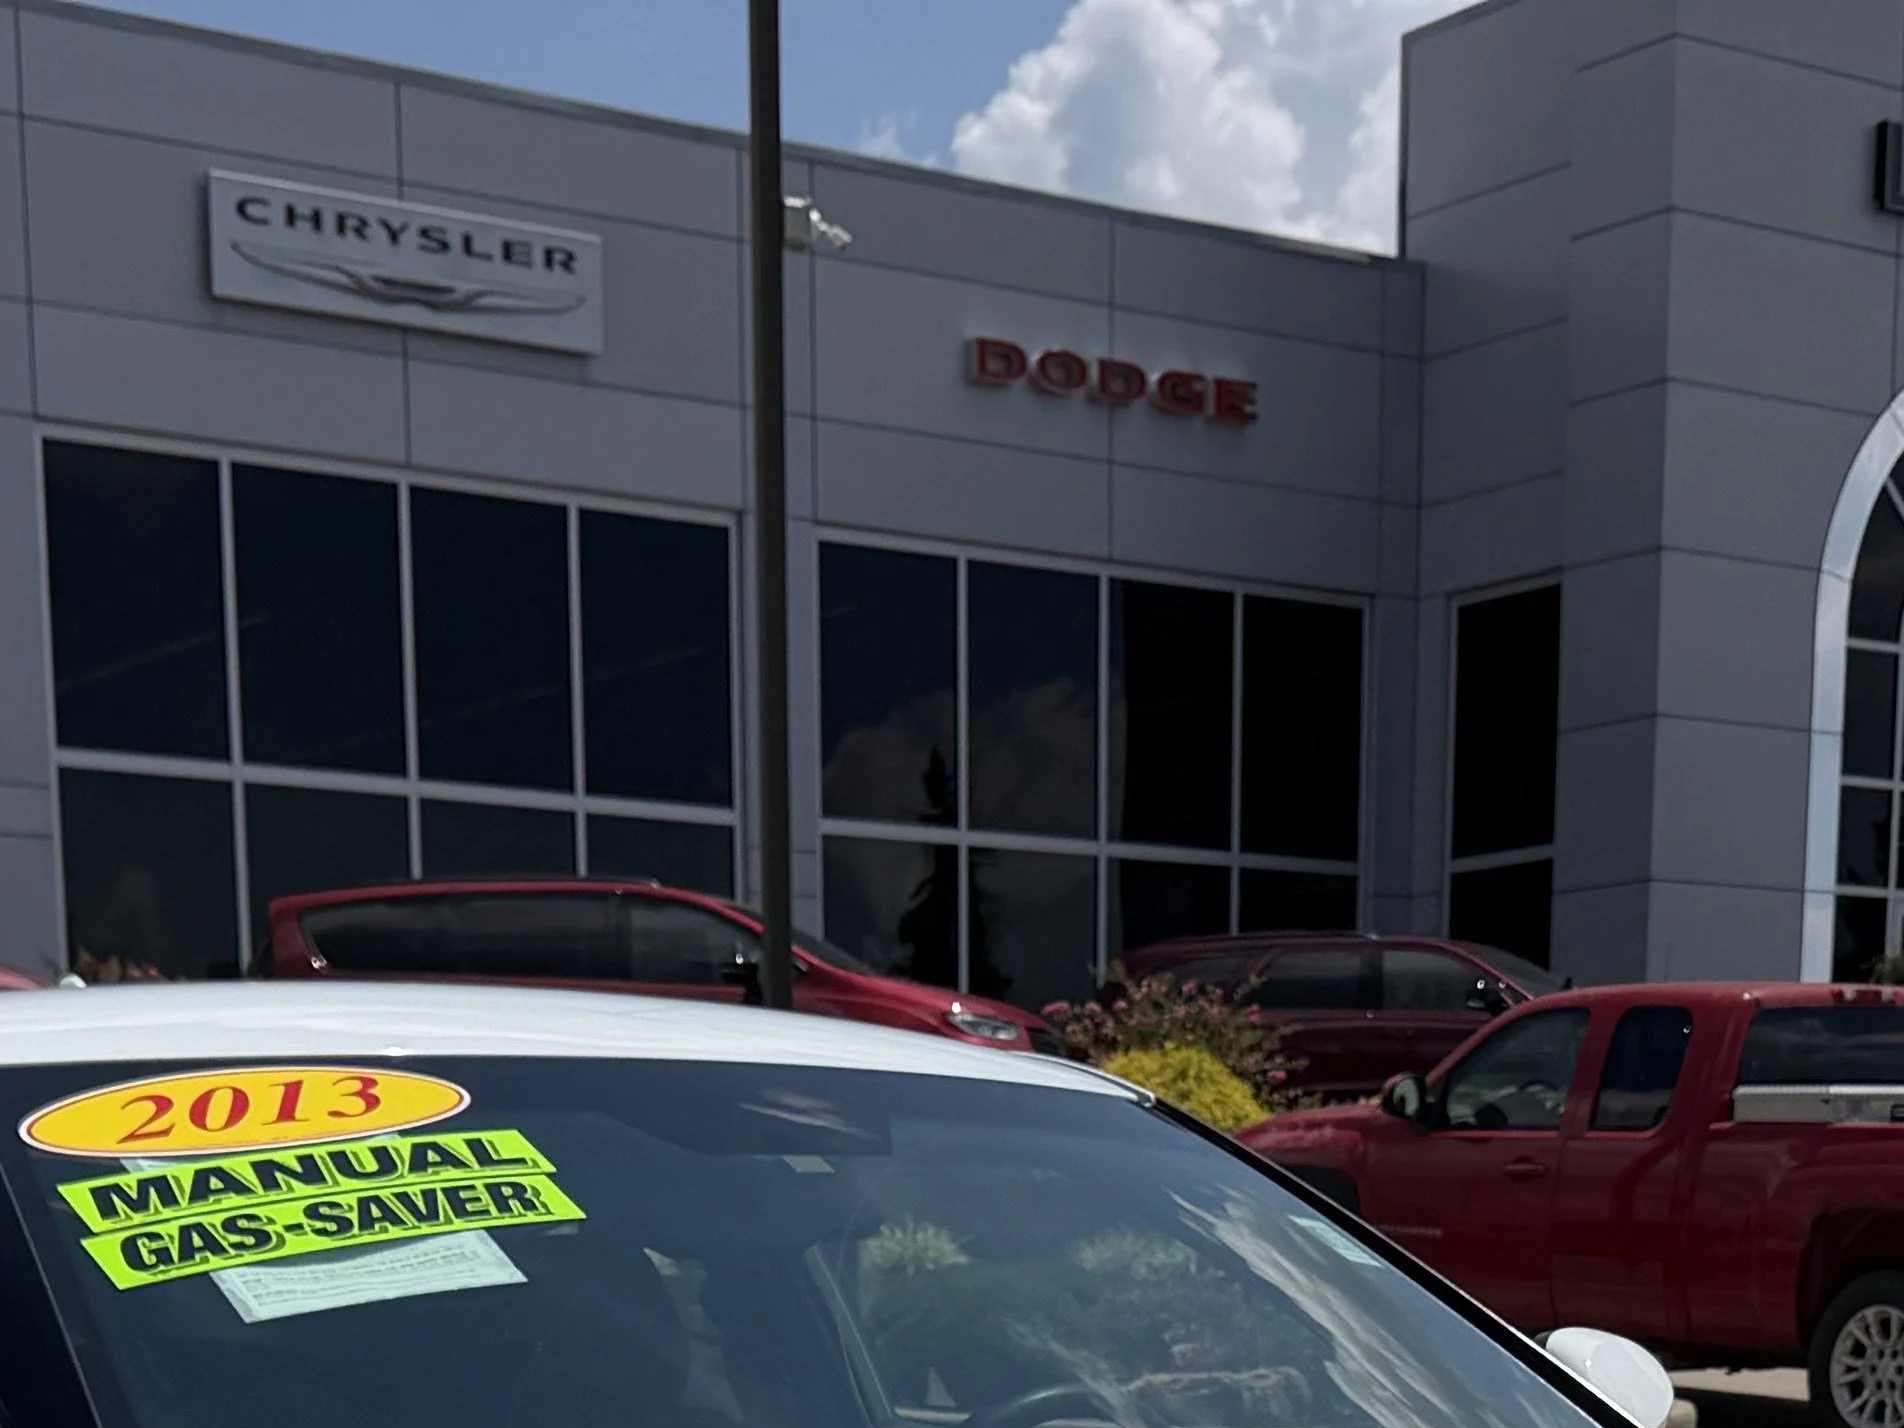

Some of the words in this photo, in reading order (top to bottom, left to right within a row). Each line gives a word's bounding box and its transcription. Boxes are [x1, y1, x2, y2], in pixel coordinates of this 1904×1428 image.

[235, 196, 578, 276] CHRYSLER
[968, 335, 1259, 424] DODGE
[115, 1075, 382, 1145] 2013
[96, 1137, 533, 1222] MANUAL
[120, 1178, 552, 1275] GAS-SAVER
